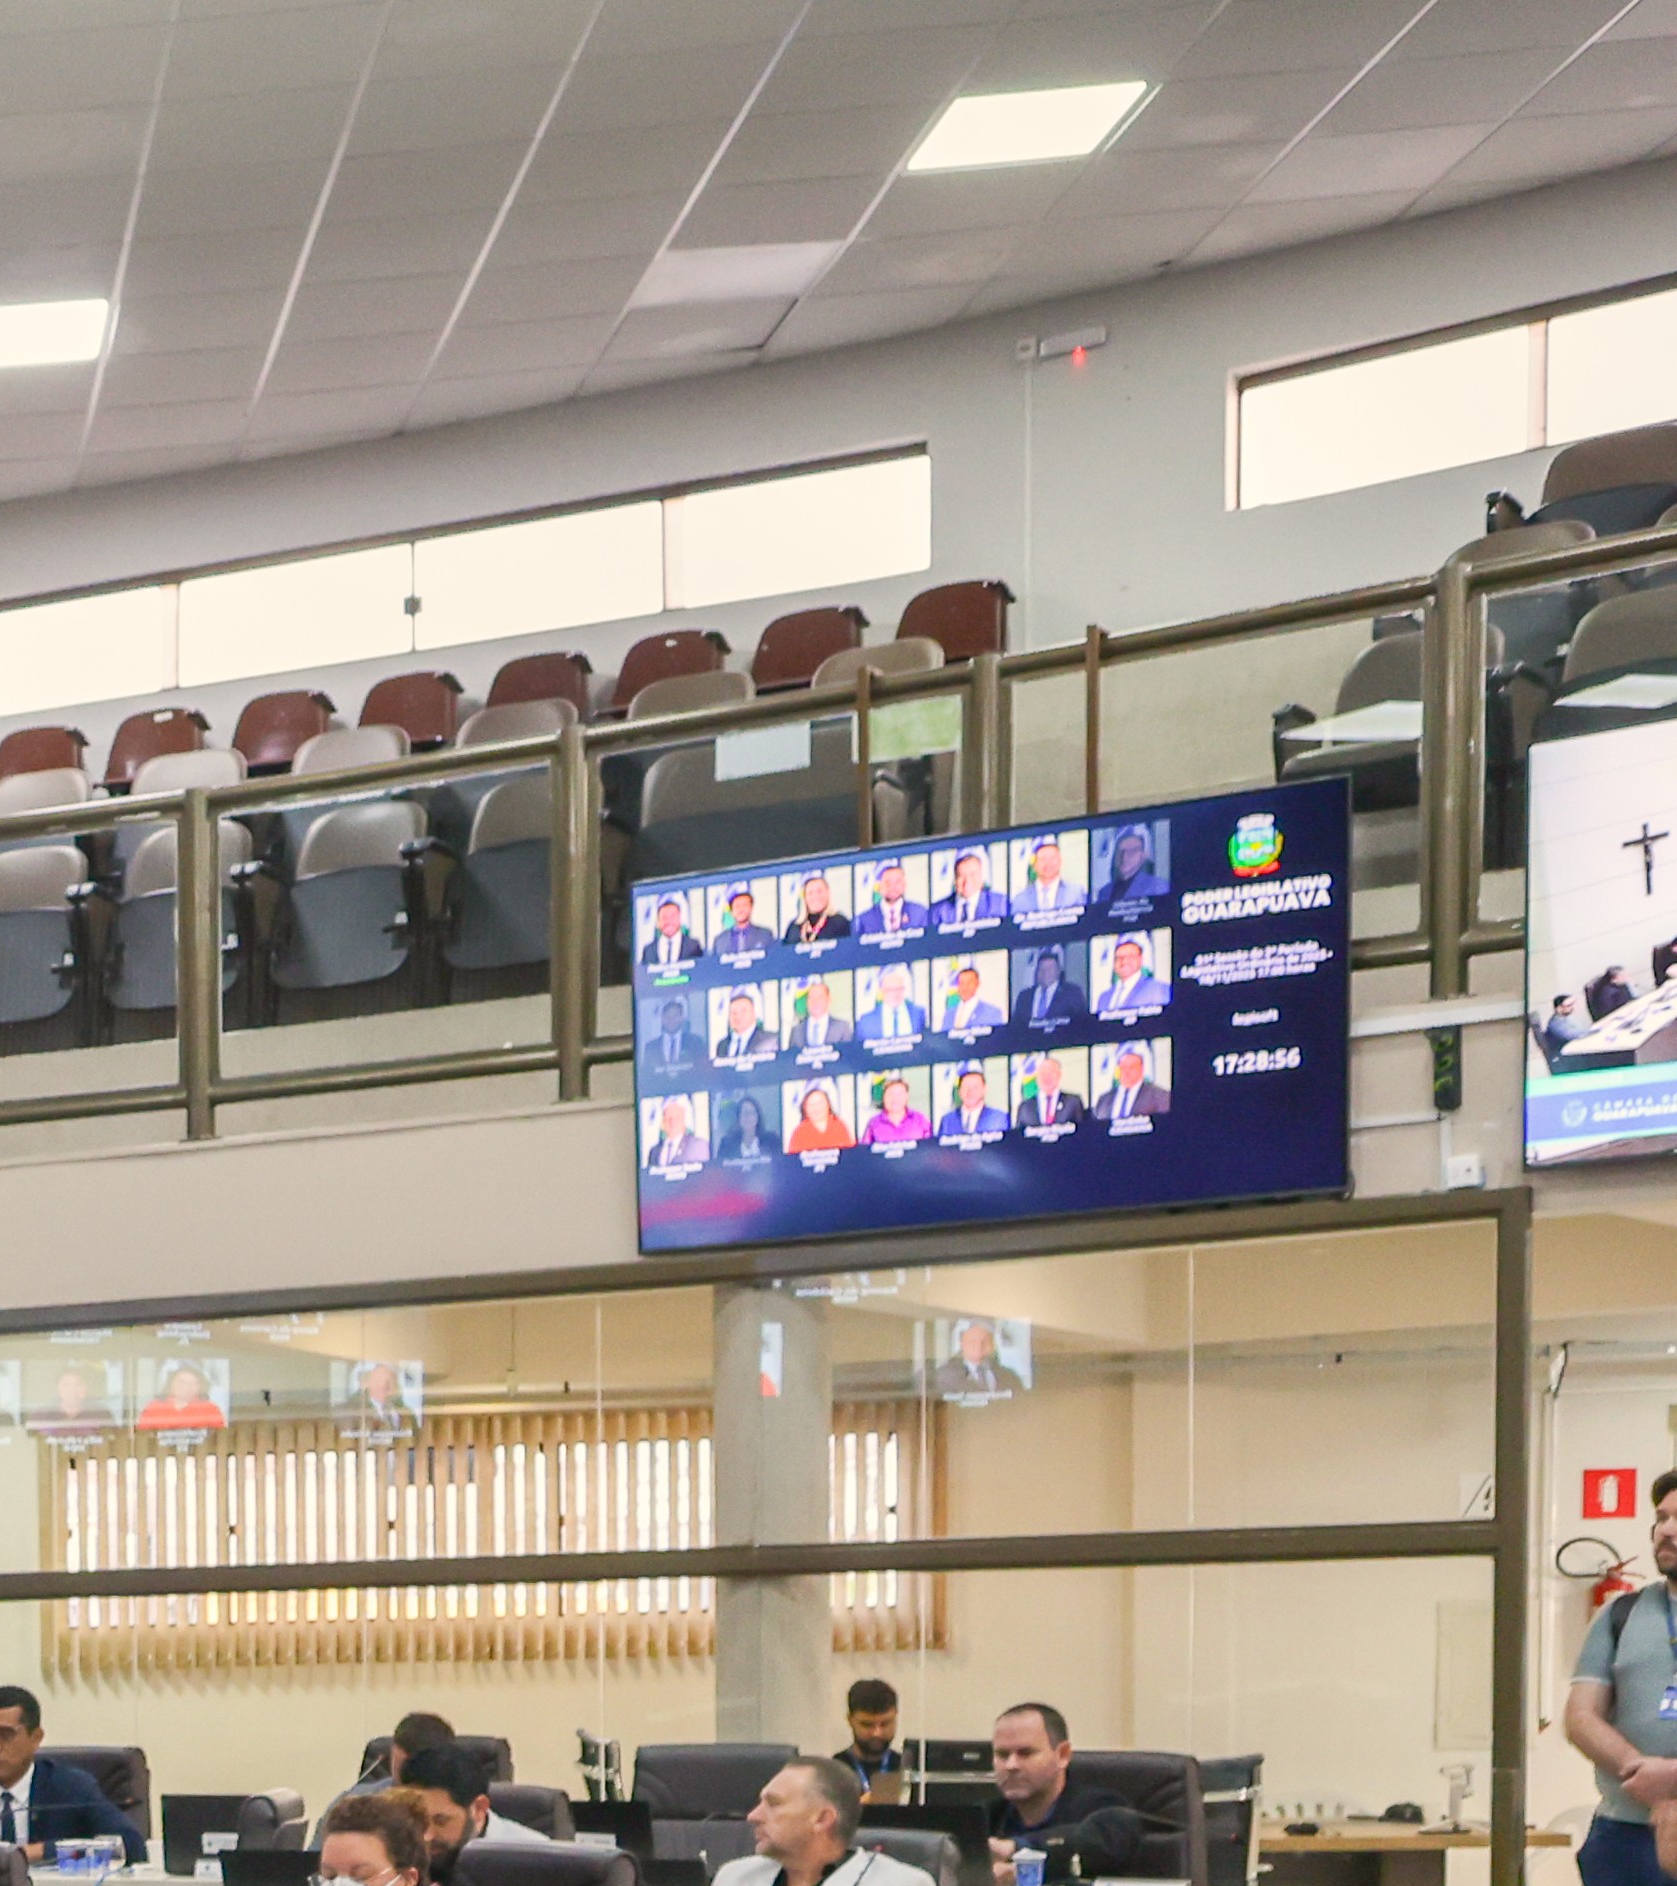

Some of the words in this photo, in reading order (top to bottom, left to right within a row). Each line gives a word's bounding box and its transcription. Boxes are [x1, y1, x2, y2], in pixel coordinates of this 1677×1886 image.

[1181, 886, 1233, 908] PODER
[1234, 873, 1332, 900] LEGISLATIVO
[1181, 889, 1332, 925] GUARAPUAVA
[1213, 1047, 1301, 1076] 17:28:56
